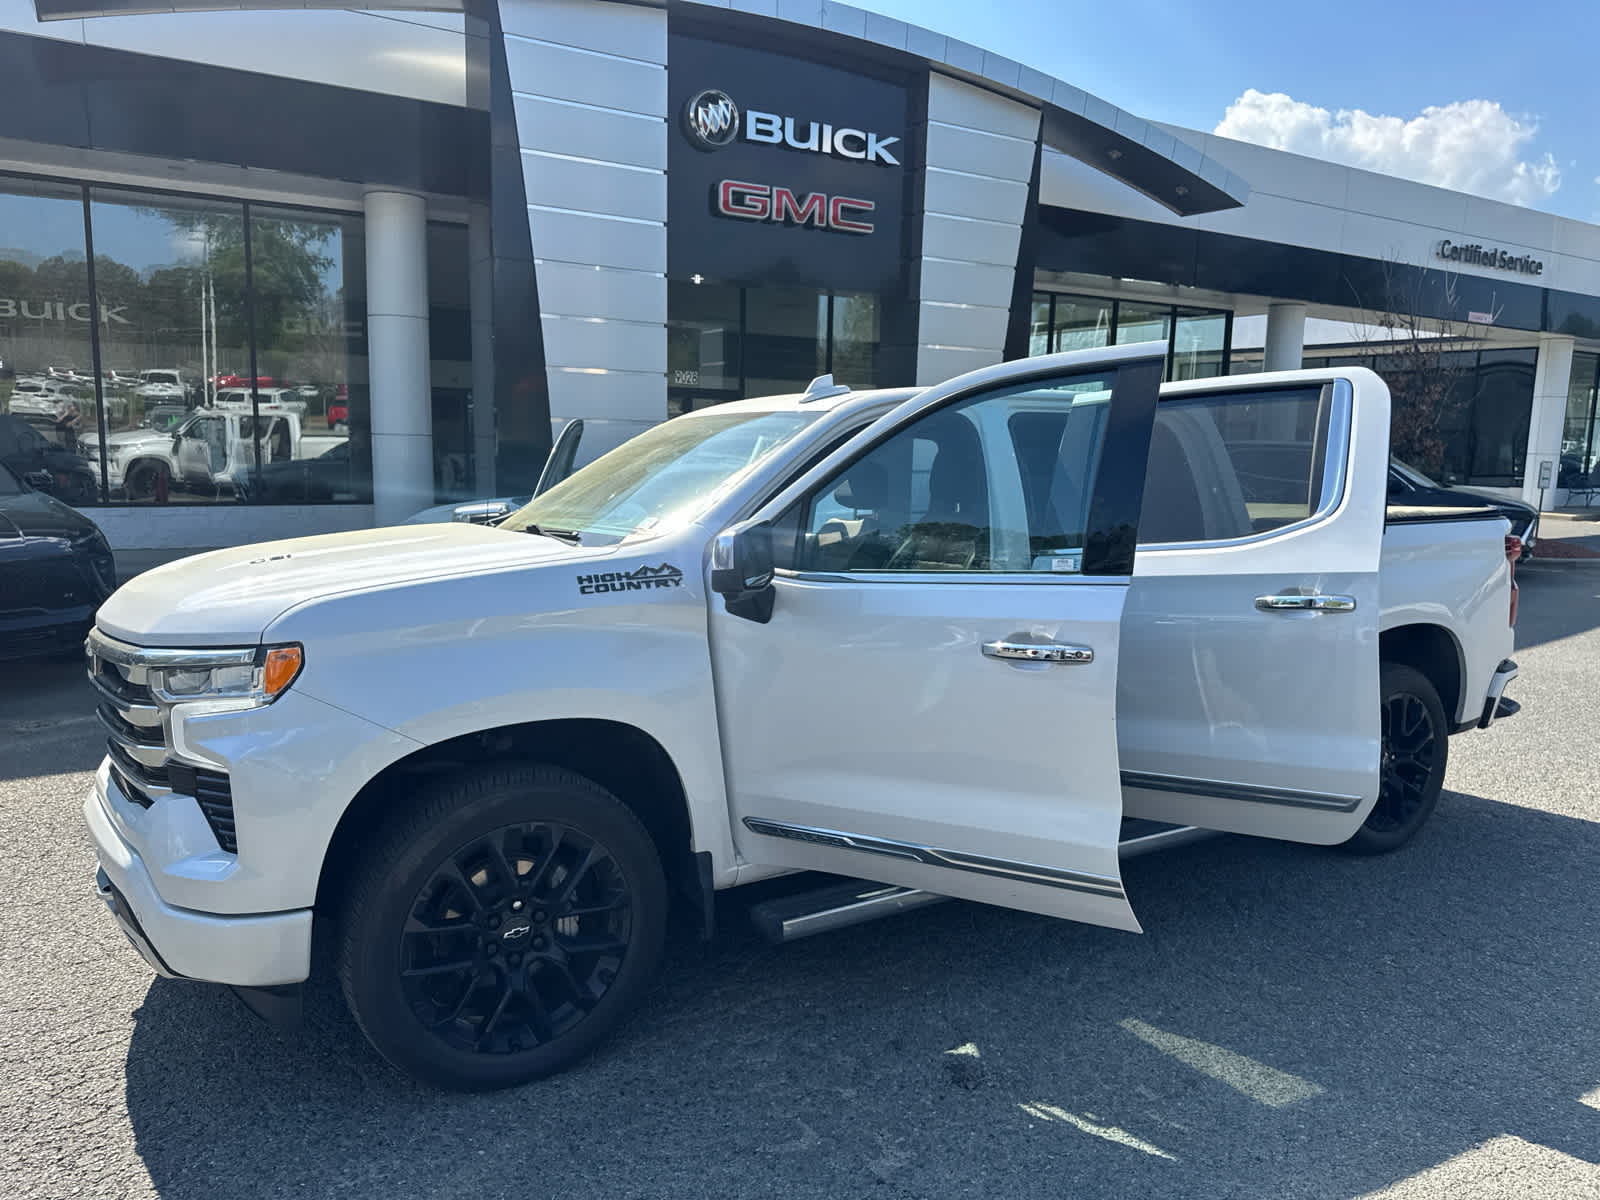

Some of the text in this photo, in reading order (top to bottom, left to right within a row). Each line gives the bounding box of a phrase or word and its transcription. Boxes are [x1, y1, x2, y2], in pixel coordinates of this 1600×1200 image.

[746, 110, 900, 166] BUICK
[719, 179, 875, 234] GMC
[1441, 240, 1543, 275] Certified Service
[0, 298, 132, 325] BUICK
[577, 571, 632, 585] HIGH
[580, 577, 682, 595] COUNTRY
